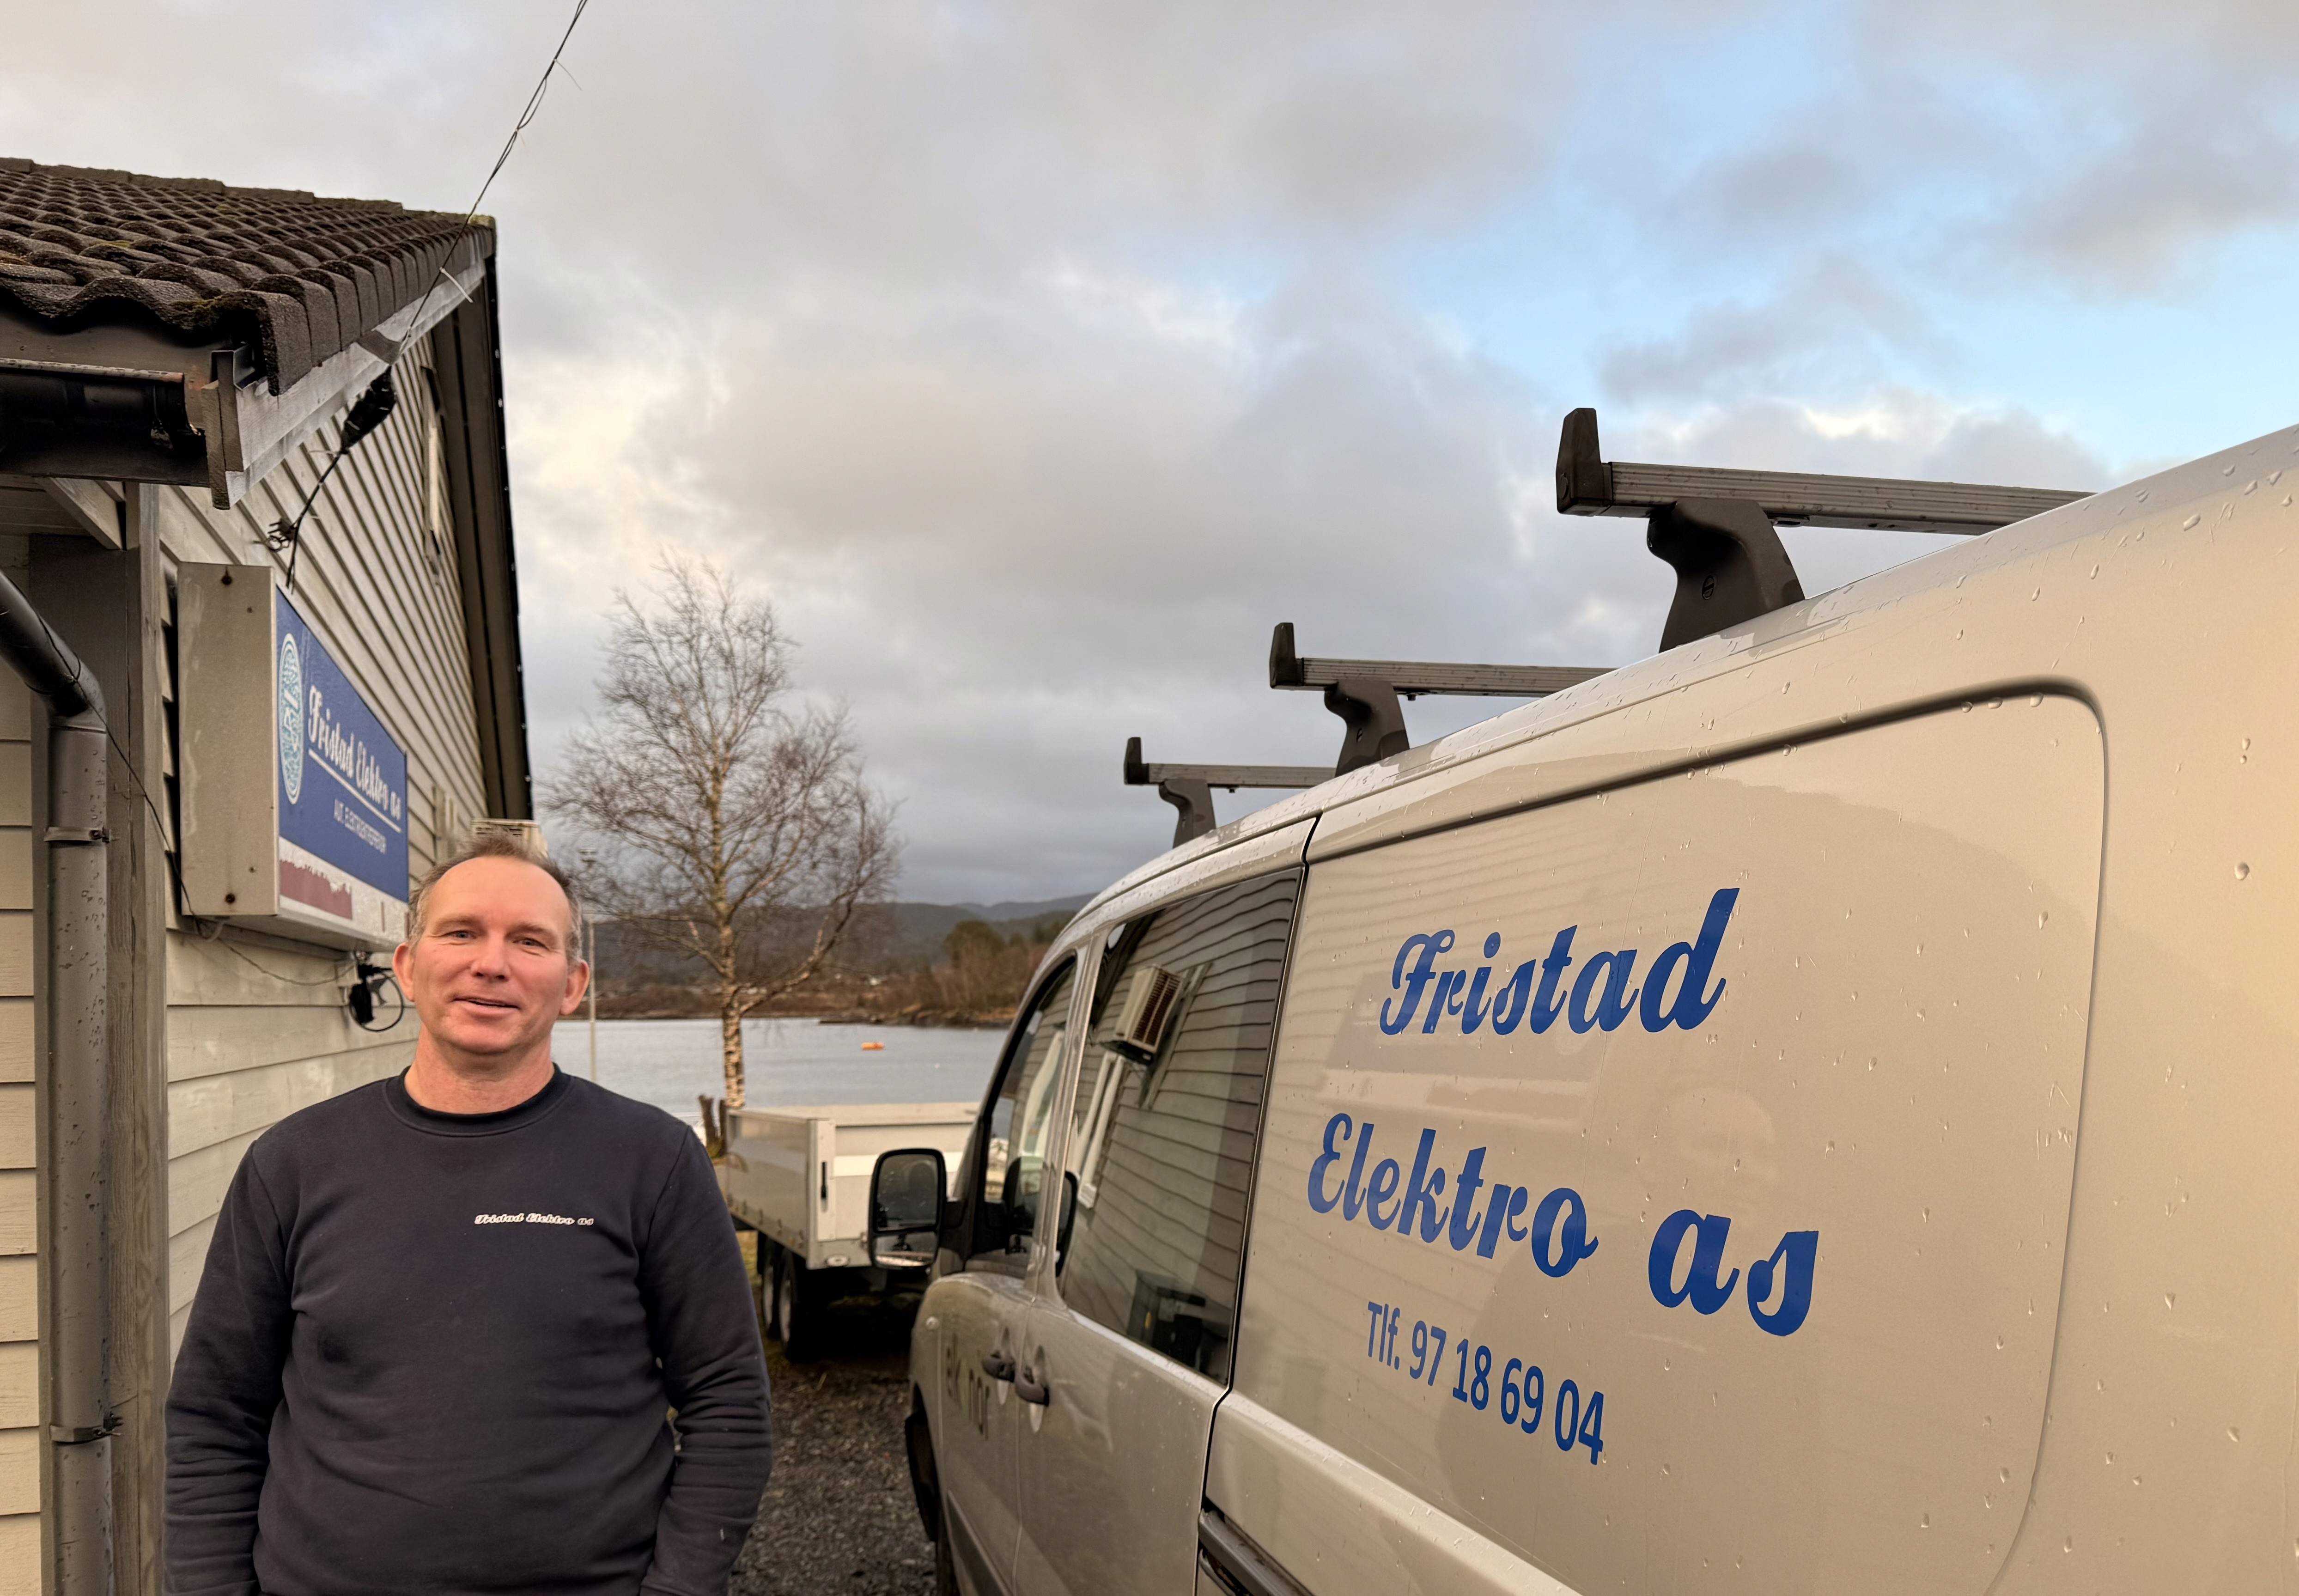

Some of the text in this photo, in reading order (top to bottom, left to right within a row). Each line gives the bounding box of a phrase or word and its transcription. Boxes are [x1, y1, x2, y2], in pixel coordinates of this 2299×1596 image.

[308, 685, 354, 779] Fristad
[356, 741, 389, 811] Elektro
[1381, 888, 1739, 1035] Fristad
[474, 1213, 524, 1224] Fristad
[525, 1213, 575, 1225] Elektro
[1308, 1114, 1819, 1336] Elektro as
[1368, 1302, 1604, 1465] Tlf. 97 18 69 04
